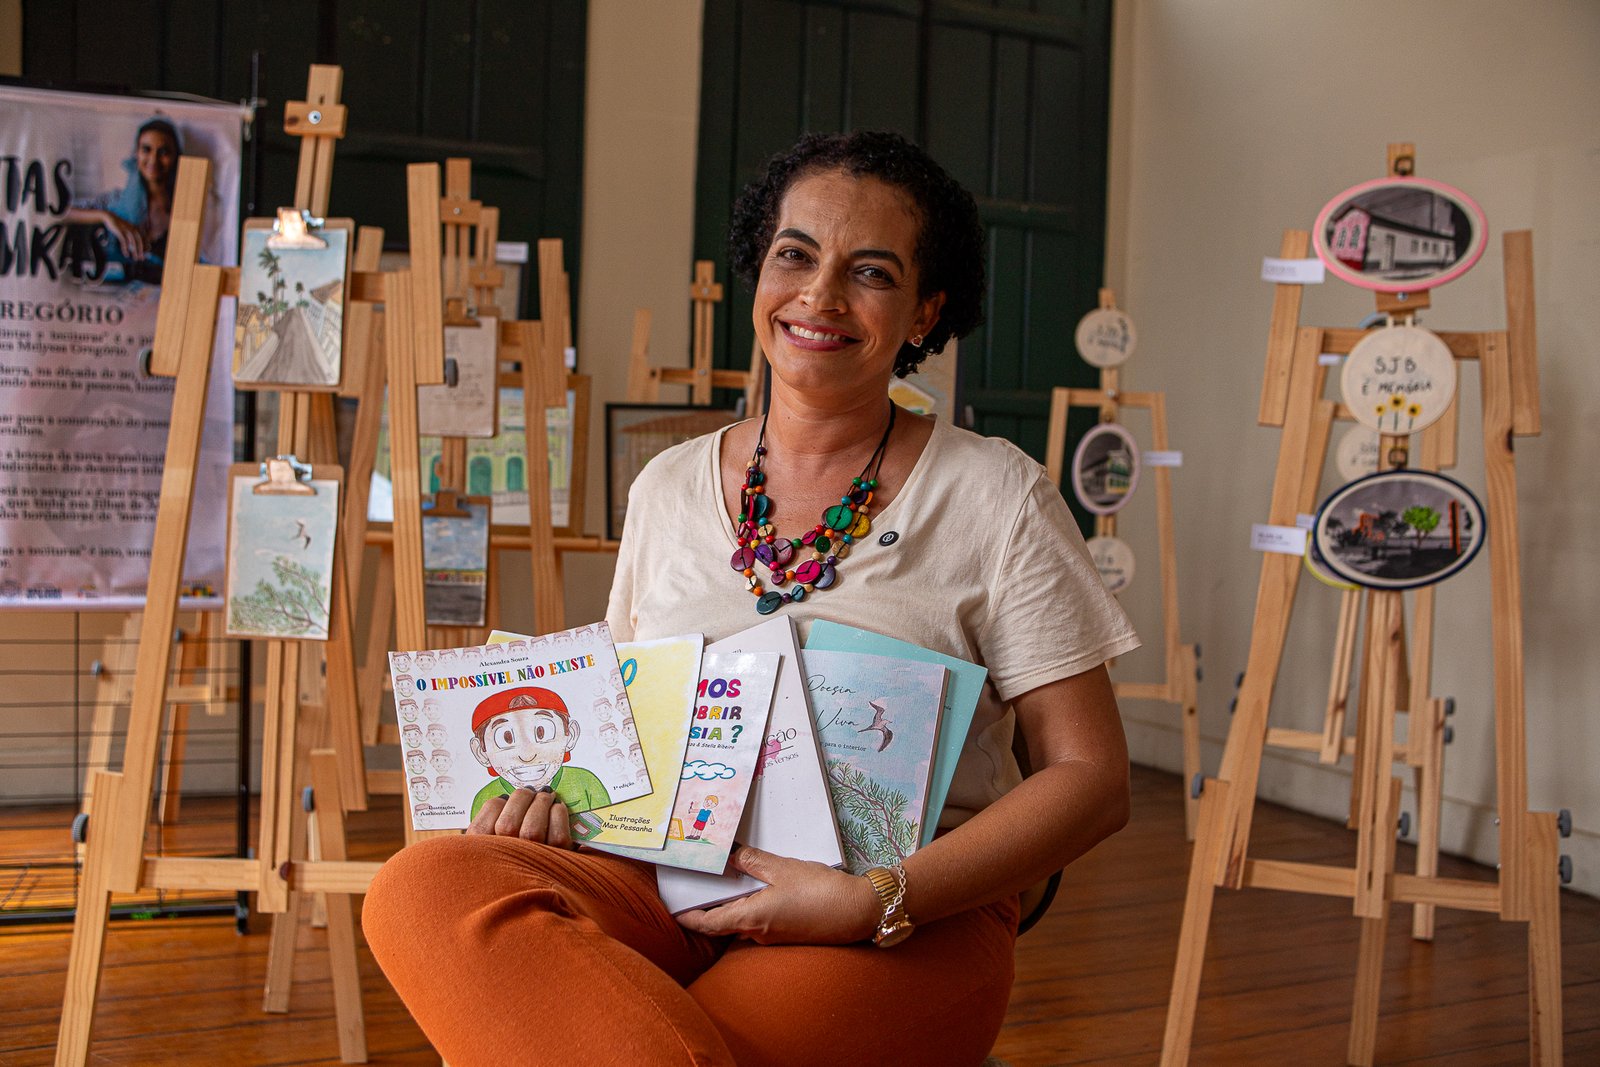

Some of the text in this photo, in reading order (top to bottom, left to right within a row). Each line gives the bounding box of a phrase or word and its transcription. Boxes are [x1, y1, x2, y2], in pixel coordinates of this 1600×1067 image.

[0, 156, 71, 215] TAS
[0, 298, 124, 326] REGÓRIO
[416, 653, 596, 692] O IMPOSSÍVEL NÃO EXISTE
[479, 659, 510, 668] Alexandra
[806, 673, 857, 696] Poesia
[816, 706, 860, 733] Viva
[689, 724, 744, 744] SIA ?
[763, 727, 797, 748] ção
[843, 743, 867, 752] interior
[602, 822, 653, 833] Max Pessanha
[609, 813, 651, 825] Ilustrações
